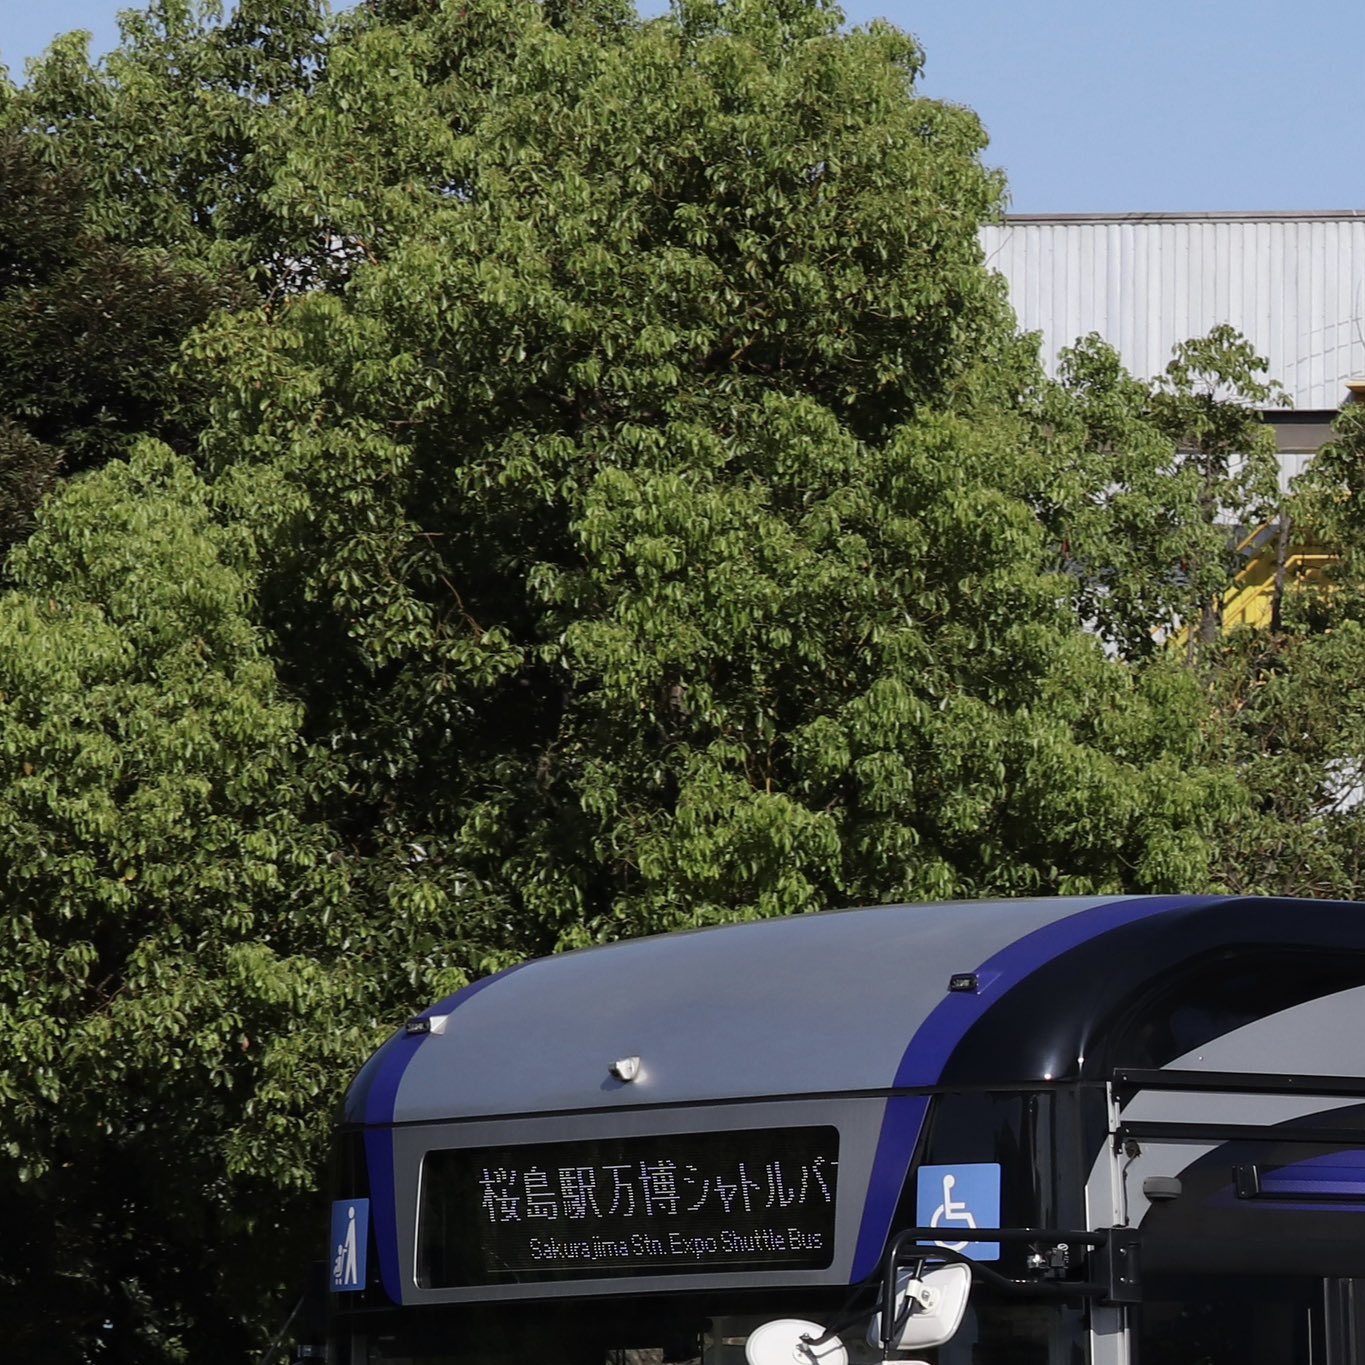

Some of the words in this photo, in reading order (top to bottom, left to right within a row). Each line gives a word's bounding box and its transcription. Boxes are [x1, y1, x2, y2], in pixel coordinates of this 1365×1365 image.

[479, 1156, 839, 1222] 桜島駅万博シャトルバ
[530, 1236, 629, 1261] Sakurajima
[630, 1233, 667, 1256] Stn.
[668, 1232, 718, 1260] Expo
[721, 1229, 785, 1252] Shuttle
[787, 1227, 824, 1250] Bus
